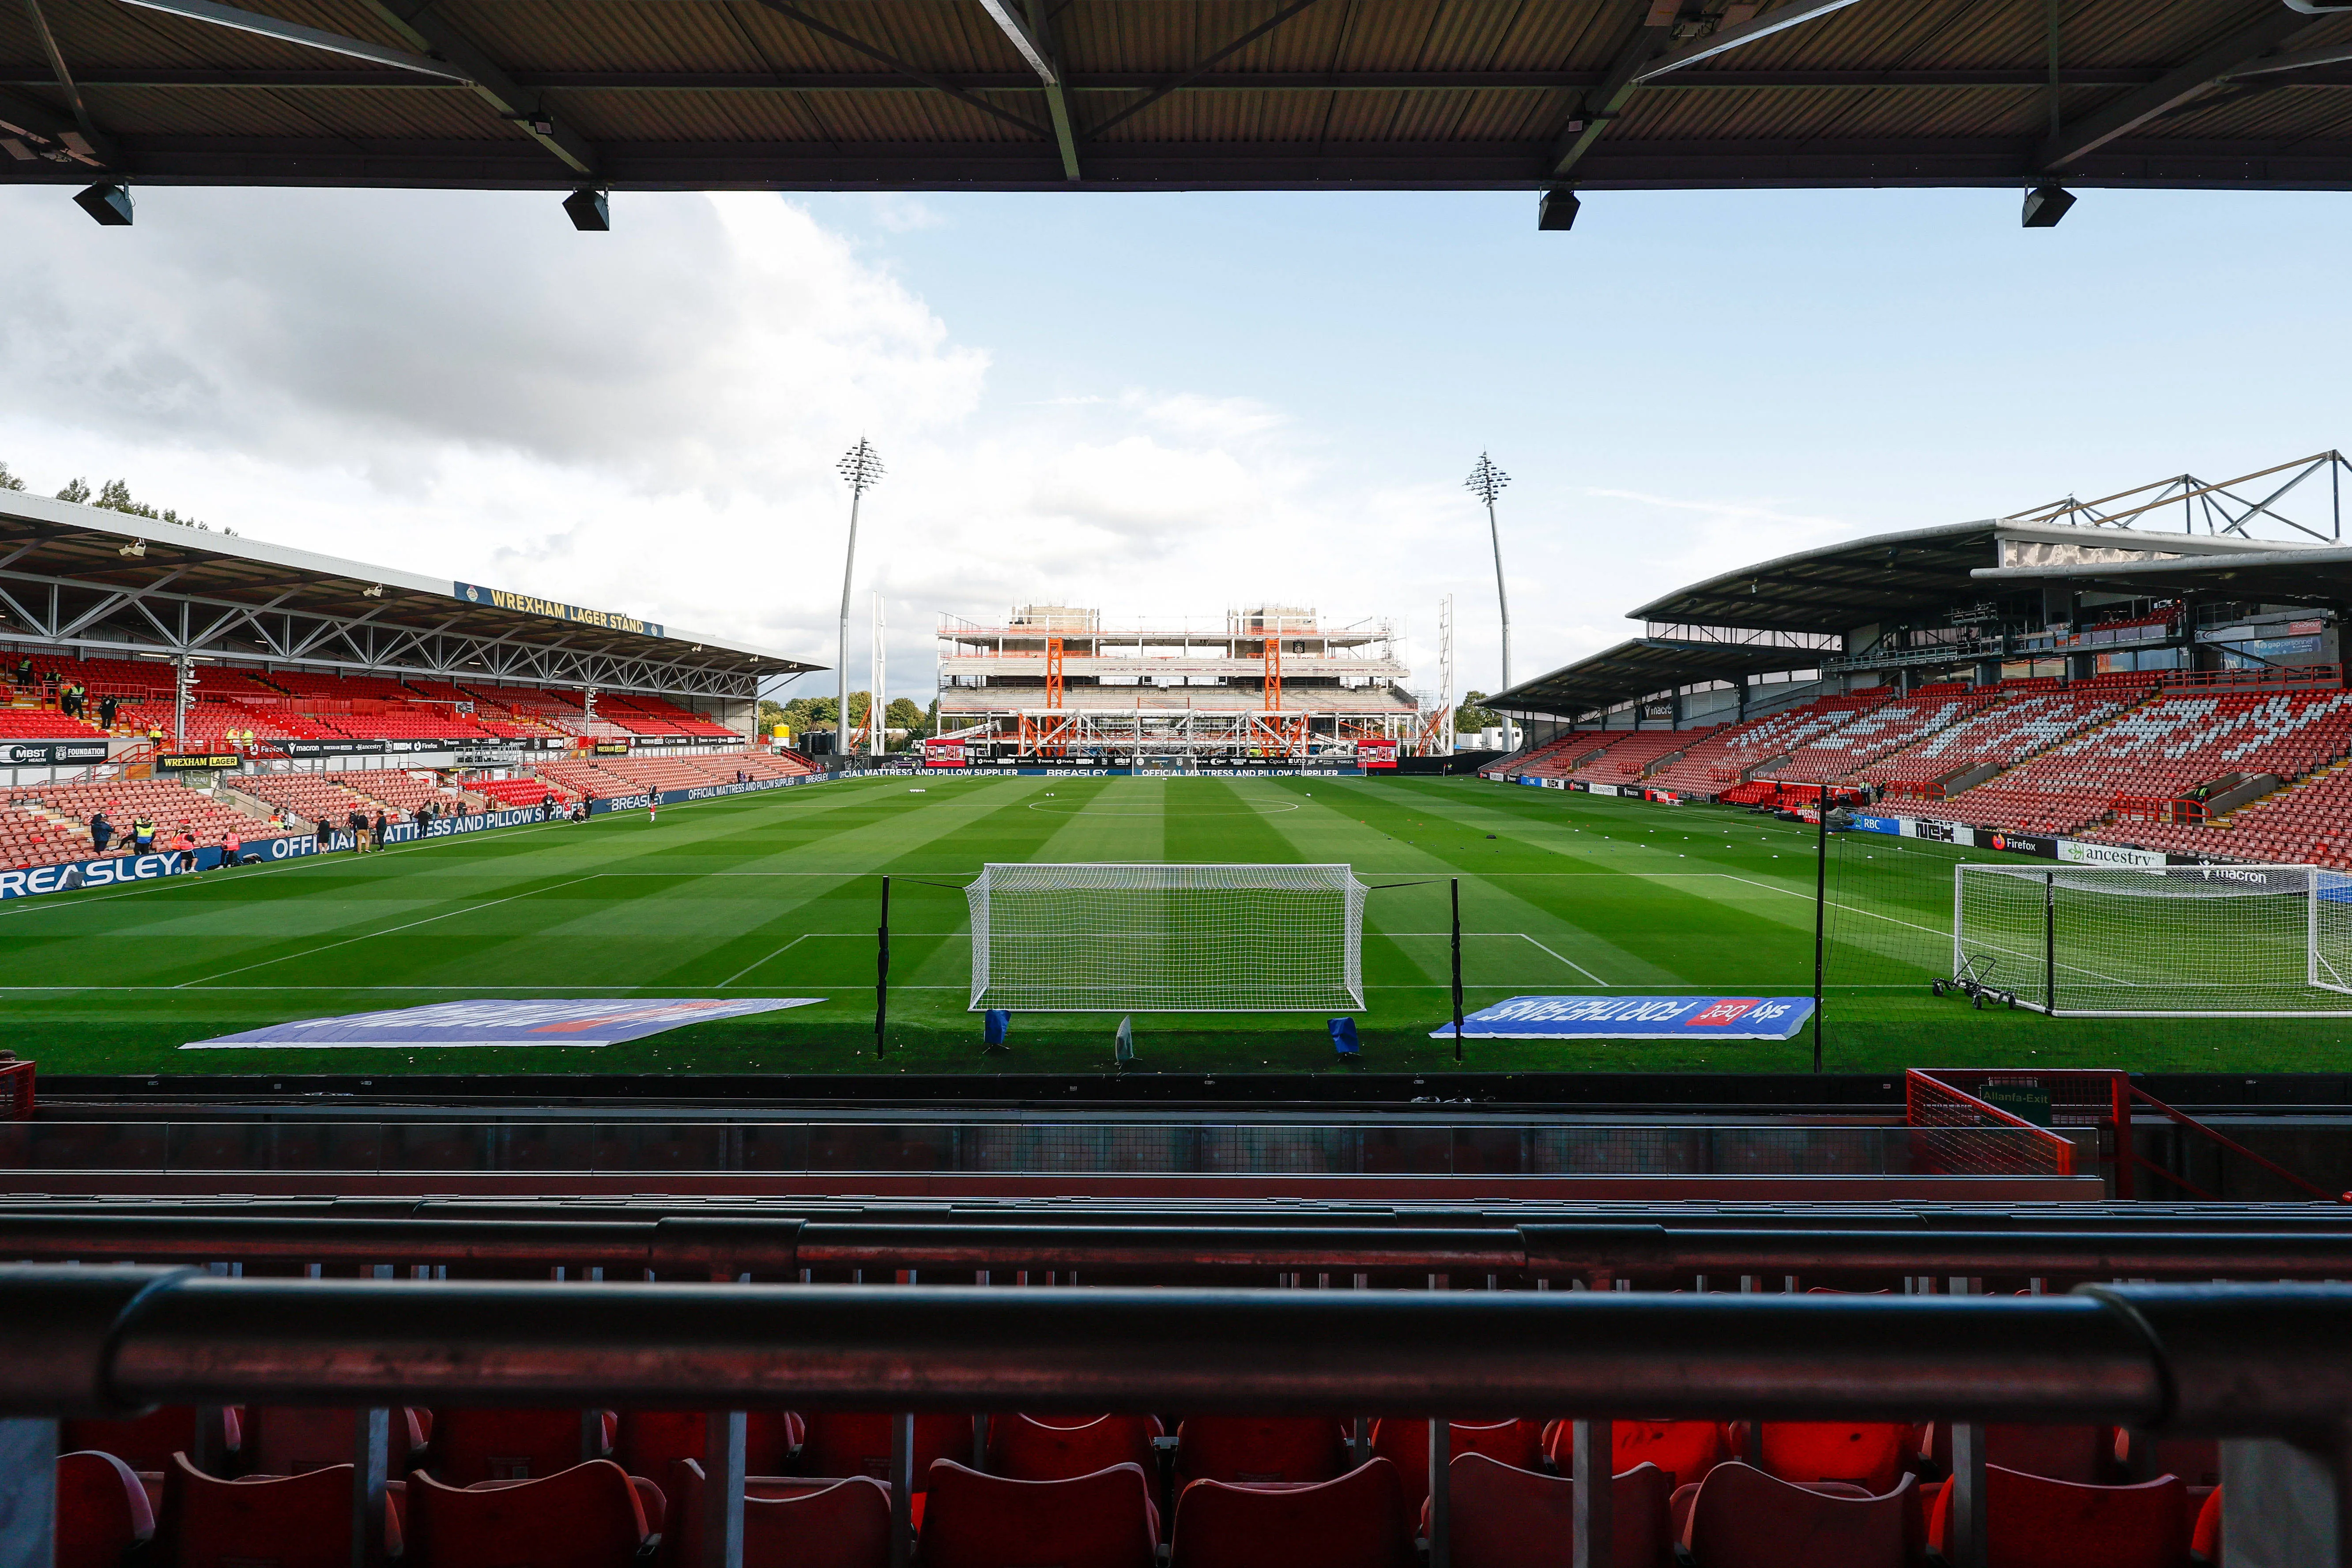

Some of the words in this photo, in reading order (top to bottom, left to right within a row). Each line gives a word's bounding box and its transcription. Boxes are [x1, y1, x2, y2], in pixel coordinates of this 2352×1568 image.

[491, 589, 565, 618] WREXHAM
[570, 607, 607, 627] LAGER
[610, 616, 644, 633] STAND
[1651, 706, 1672, 715] macro
[164, 758, 207, 766] WREXHAM
[805, 773, 829, 784] BREASLEY
[688, 787, 715, 800] OFFICIAL
[716, 783, 744, 796] MATTRESS
[745, 782, 756, 792] AND
[757, 779, 774, 791] PILLOW
[775, 777, 794, 789] SUPPLIER
[1597, 786, 1613, 795] ancestry
[454, 814, 483, 833] AND
[487, 808, 533, 829] PILLOW
[1797, 809, 1820, 822] WRECSA
[1864, 818, 1880, 830] RBC
[1916, 822, 1954, 843] NEX
[2007, 838, 2036, 852] Firefox
[2087, 848, 2151, 866] ancestry
[2216, 870, 2266, 883] macron
[1568, 1001, 1636, 1021] THE
[1615, 1001, 1698, 1021] FOR
[1700, 1005, 1749, 1022] bet
[1743, 1001, 1791, 1024] sky
[1984, 1091, 2048, 1104] Allanfa-Exit
